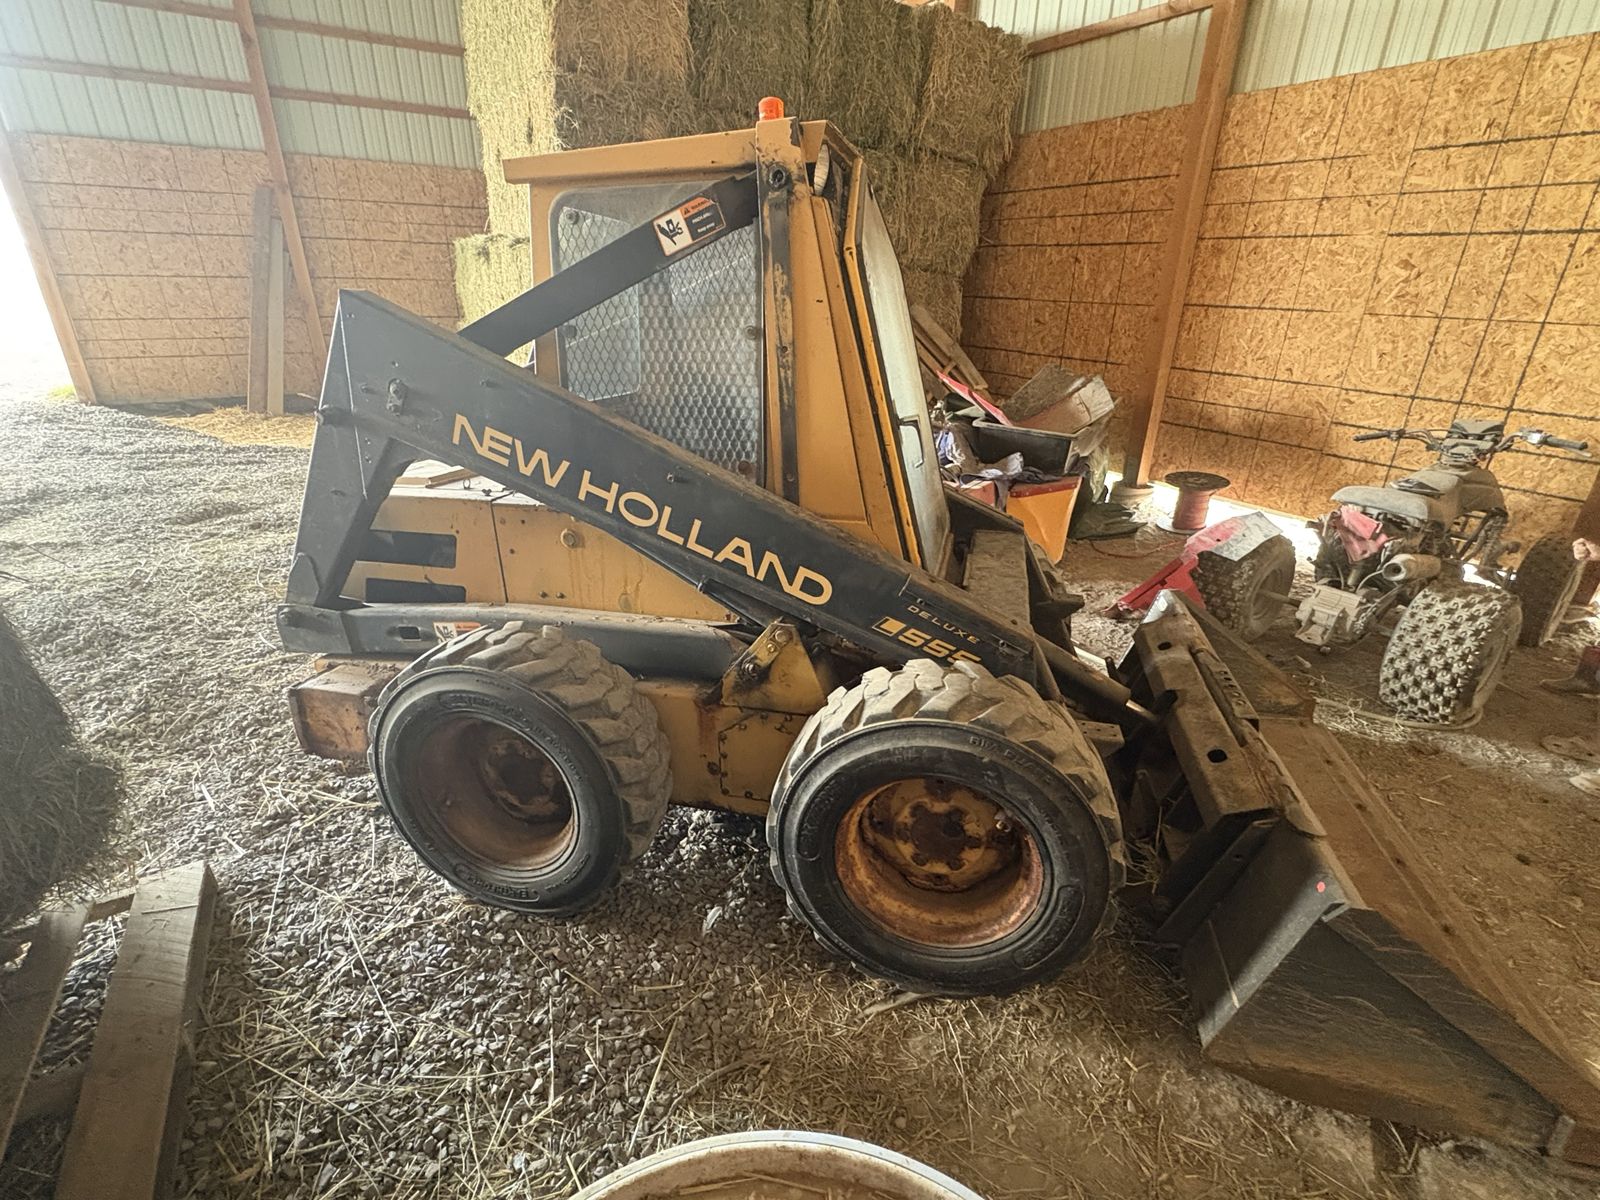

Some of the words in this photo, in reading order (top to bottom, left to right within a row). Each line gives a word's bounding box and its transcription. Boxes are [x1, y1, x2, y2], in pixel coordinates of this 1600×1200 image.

[452, 413, 571, 489] NEW
[577, 469, 833, 606] HOLLAND
[907, 605, 981, 645] DELUXE
